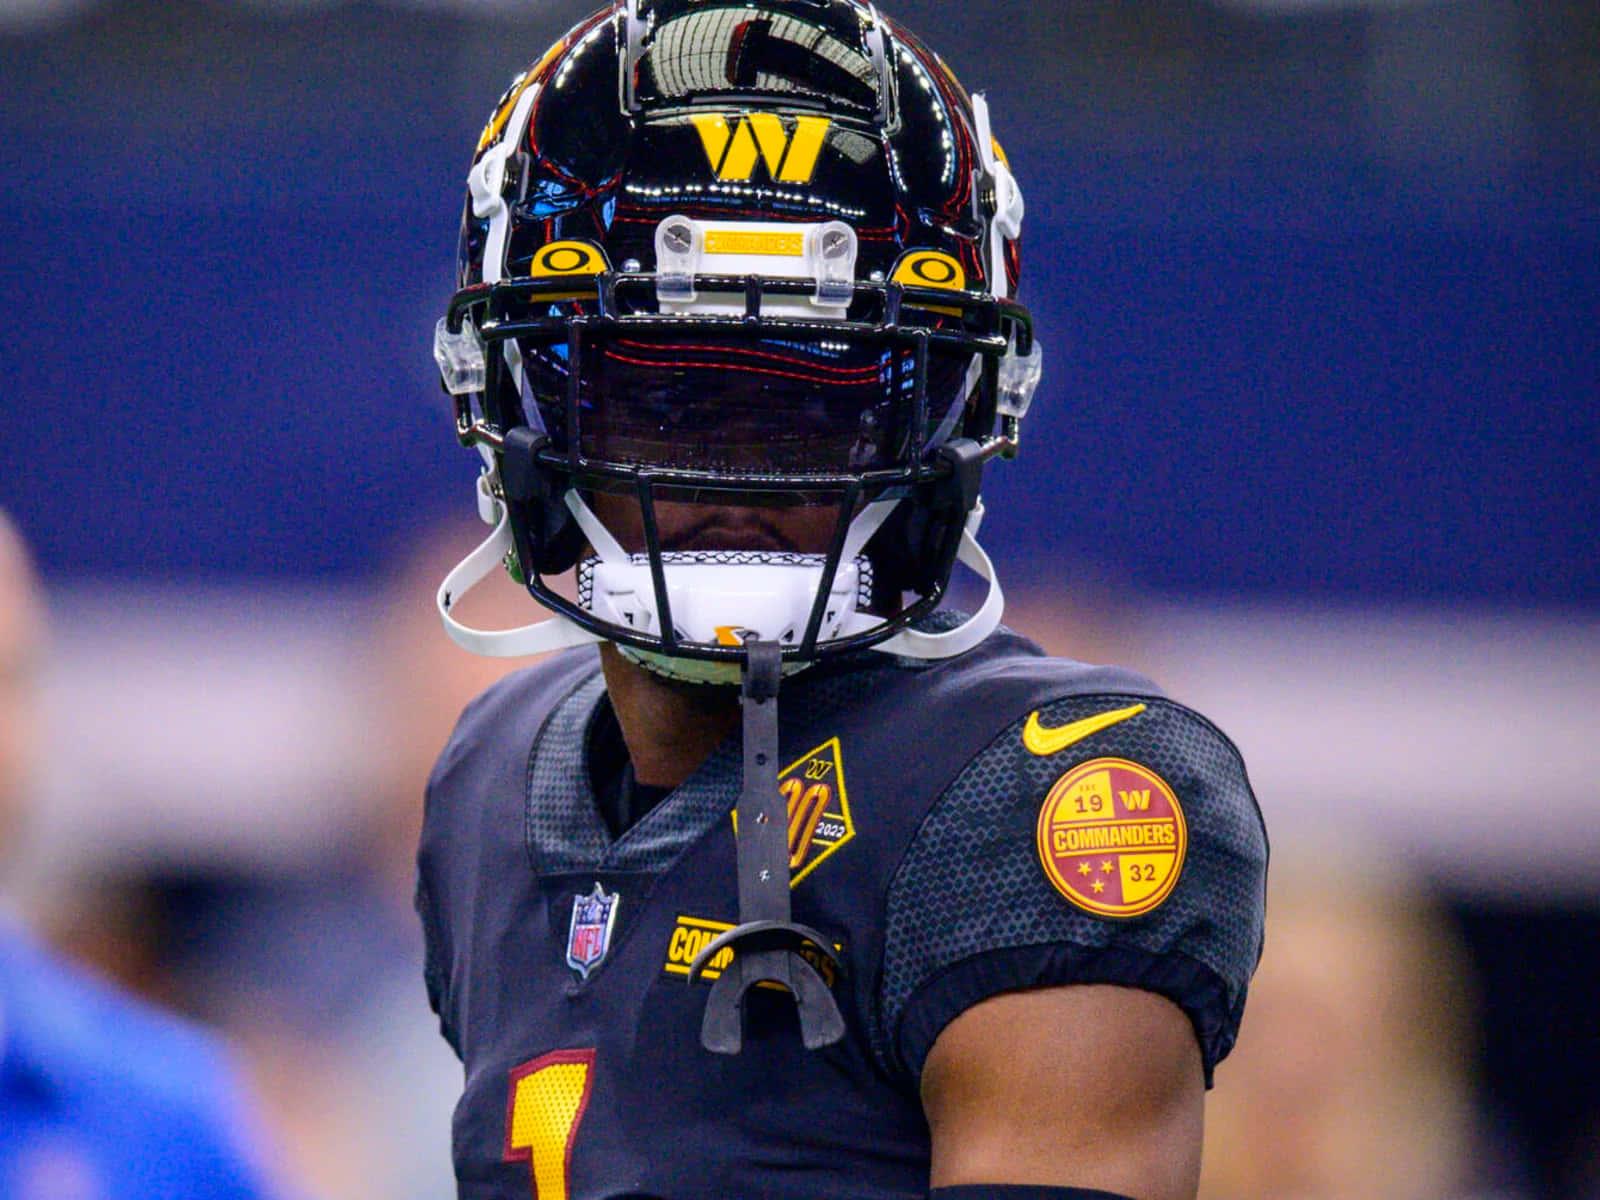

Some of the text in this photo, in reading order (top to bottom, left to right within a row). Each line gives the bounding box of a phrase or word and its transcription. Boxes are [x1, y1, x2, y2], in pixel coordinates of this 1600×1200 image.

[690, 113, 831, 182] W
[1074, 794, 1102, 813] 19
[815, 821, 845, 838] 2022
[1054, 824, 1176, 851] COMMANDERS
[1130, 864, 1156, 882] 32
[573, 927, 601, 961] NFL
[503, 1048, 597, 1200] 1
